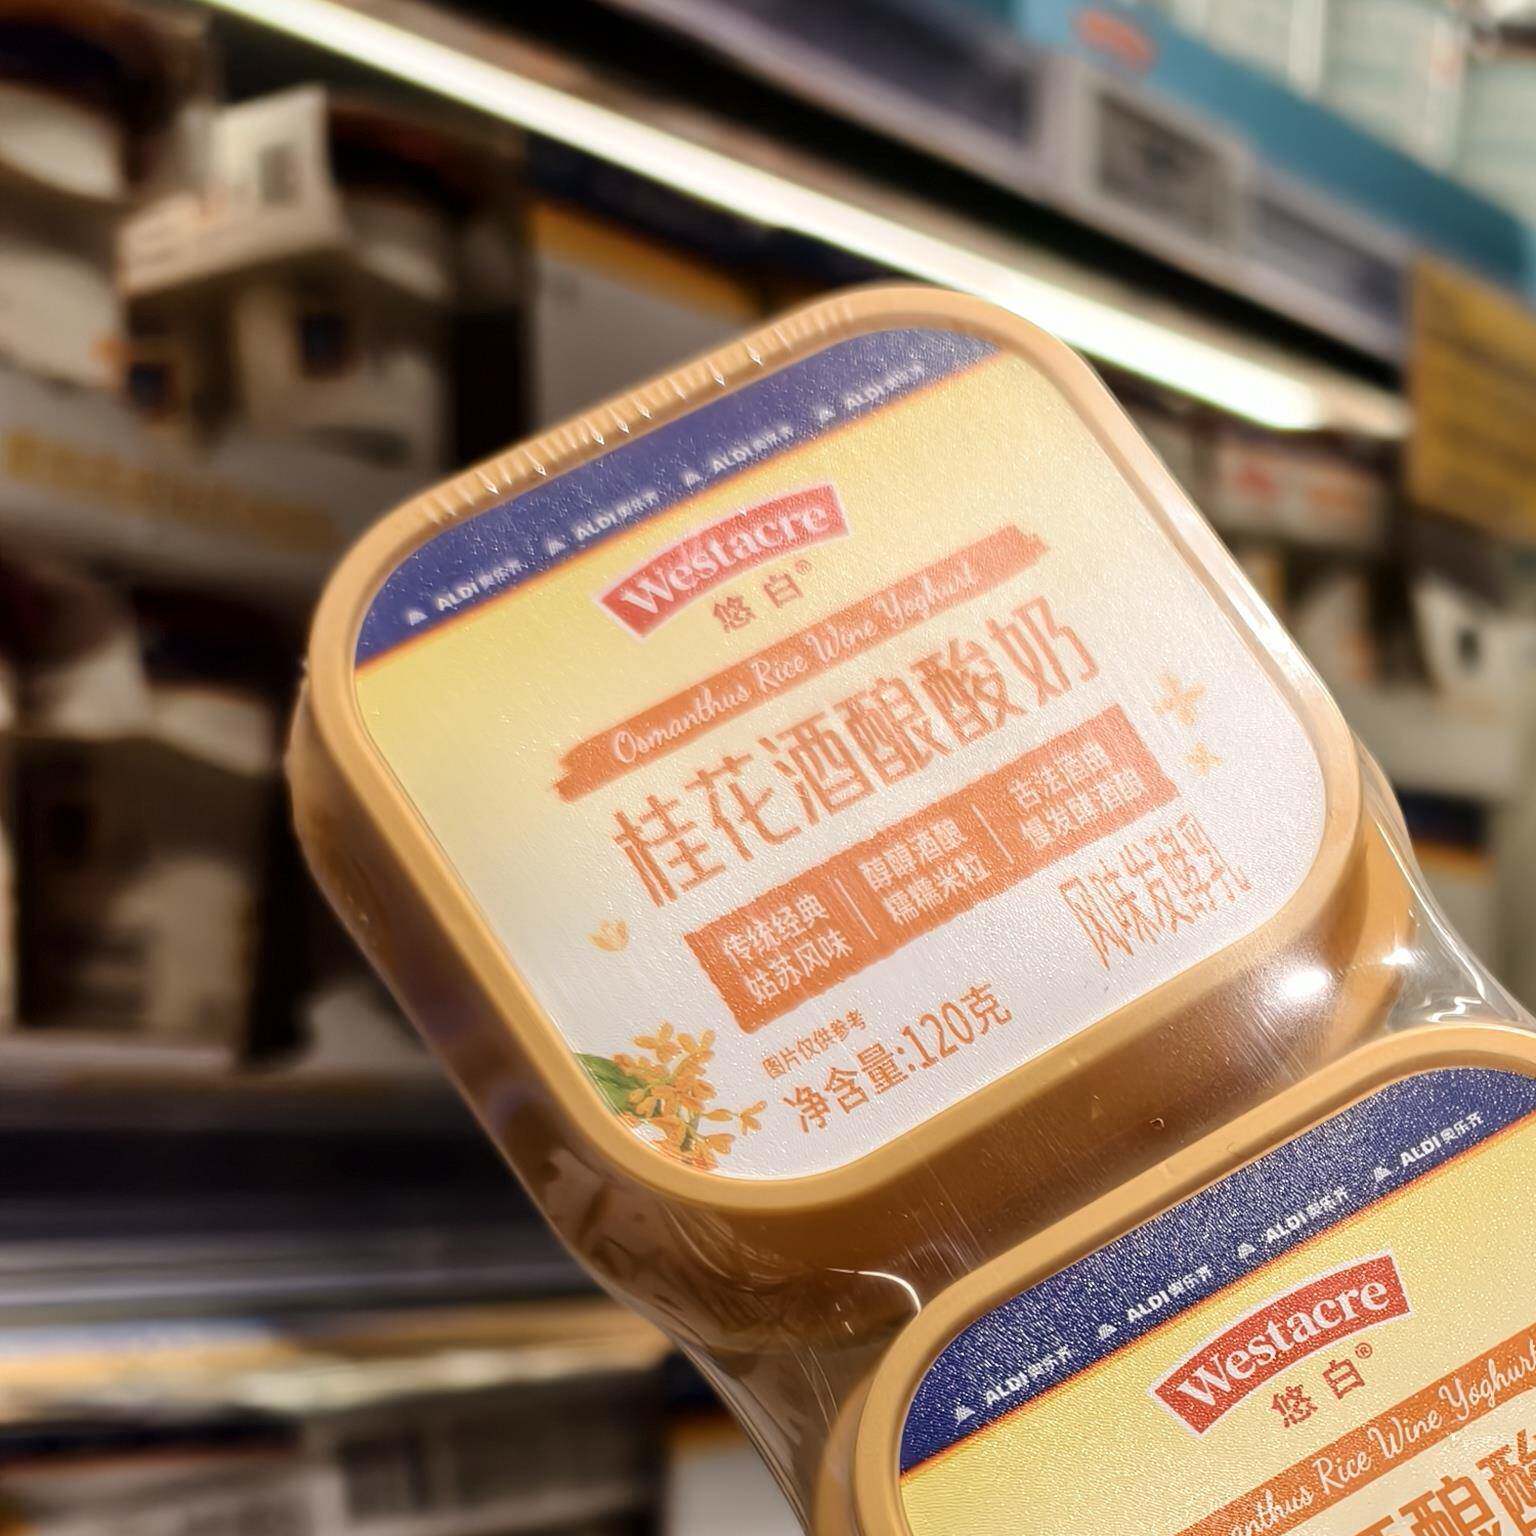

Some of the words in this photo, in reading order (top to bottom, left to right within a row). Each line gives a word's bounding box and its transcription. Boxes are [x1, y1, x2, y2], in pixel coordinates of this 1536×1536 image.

[620, 502, 831, 615] Westacre
[612, 683, 749, 764] Osmanthus
[753, 656, 806, 692] Rice
[807, 622, 878, 664] Wine
[613, 597, 1100, 908] 桂花酒酿酸奶
[1177, 1277, 1389, 1407] Westacre
[1314, 1451, 1371, 1491] Rice
[1368, 1412, 1443, 1461] Wine
